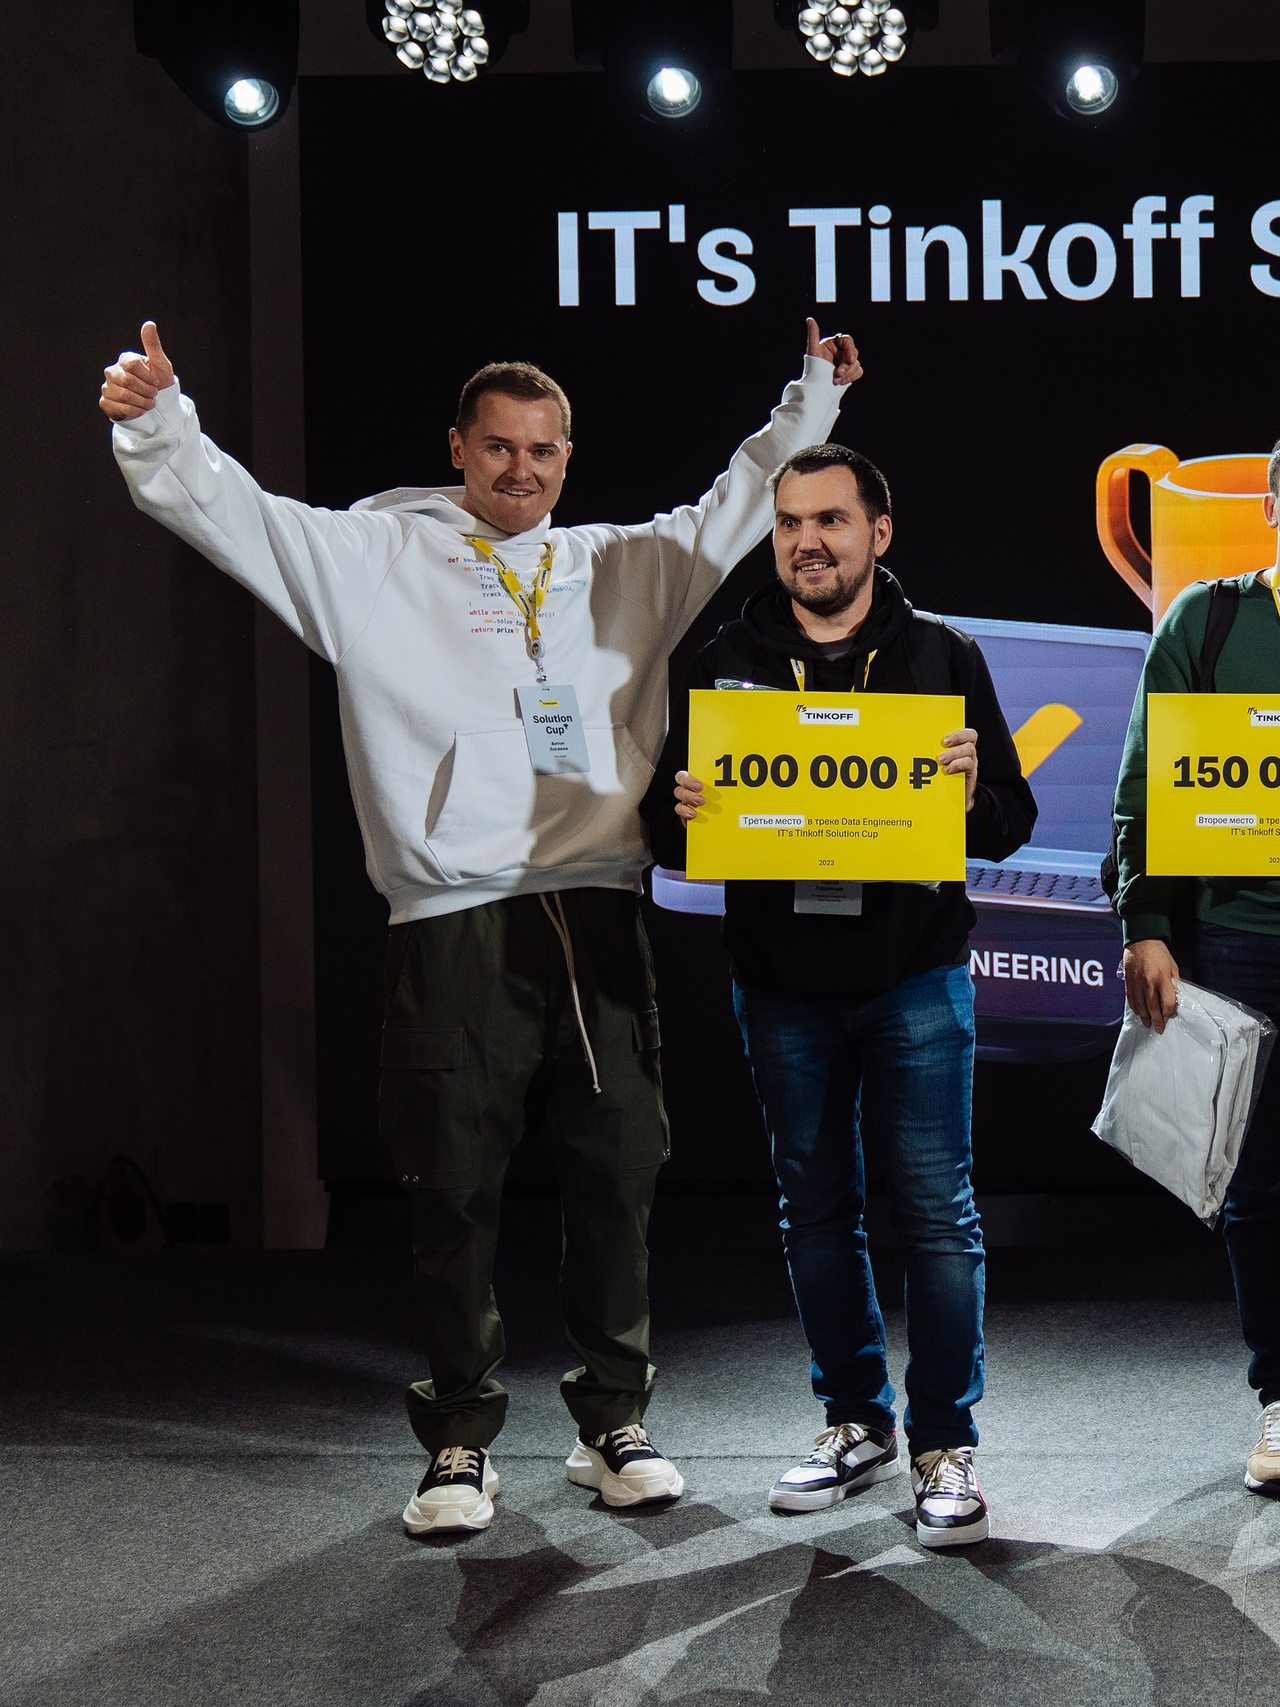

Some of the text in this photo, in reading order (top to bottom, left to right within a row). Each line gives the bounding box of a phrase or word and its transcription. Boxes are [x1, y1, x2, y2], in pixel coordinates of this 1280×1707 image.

[558, 204, 756, 306] IT's
[788, 195, 1215, 302] Tinkoff
[533, 714, 573, 723] Solution
[805, 712, 854, 720] TINKOFF
[546, 726, 565, 736] Cup
[714, 754, 939, 789] 100 000 ₽
[1173, 756, 1249, 788] 150
[743, 817, 774, 827] Третье
[775, 818, 802, 826] место
[815, 819, 840, 828] треке
[841, 818, 861, 826] Data
[863, 818, 912, 828] Engineering
[1198, 816, 1228, 826] Второе
[795, 829, 824, 837] Tinkoff
[825, 830, 860, 838] Solution
[861, 830, 878, 840] Cup
[1231, 828, 1246, 836] IT's
[1247, 828, 1274, 836] Tinkoff
[969, 950, 1104, 987] NEERING
